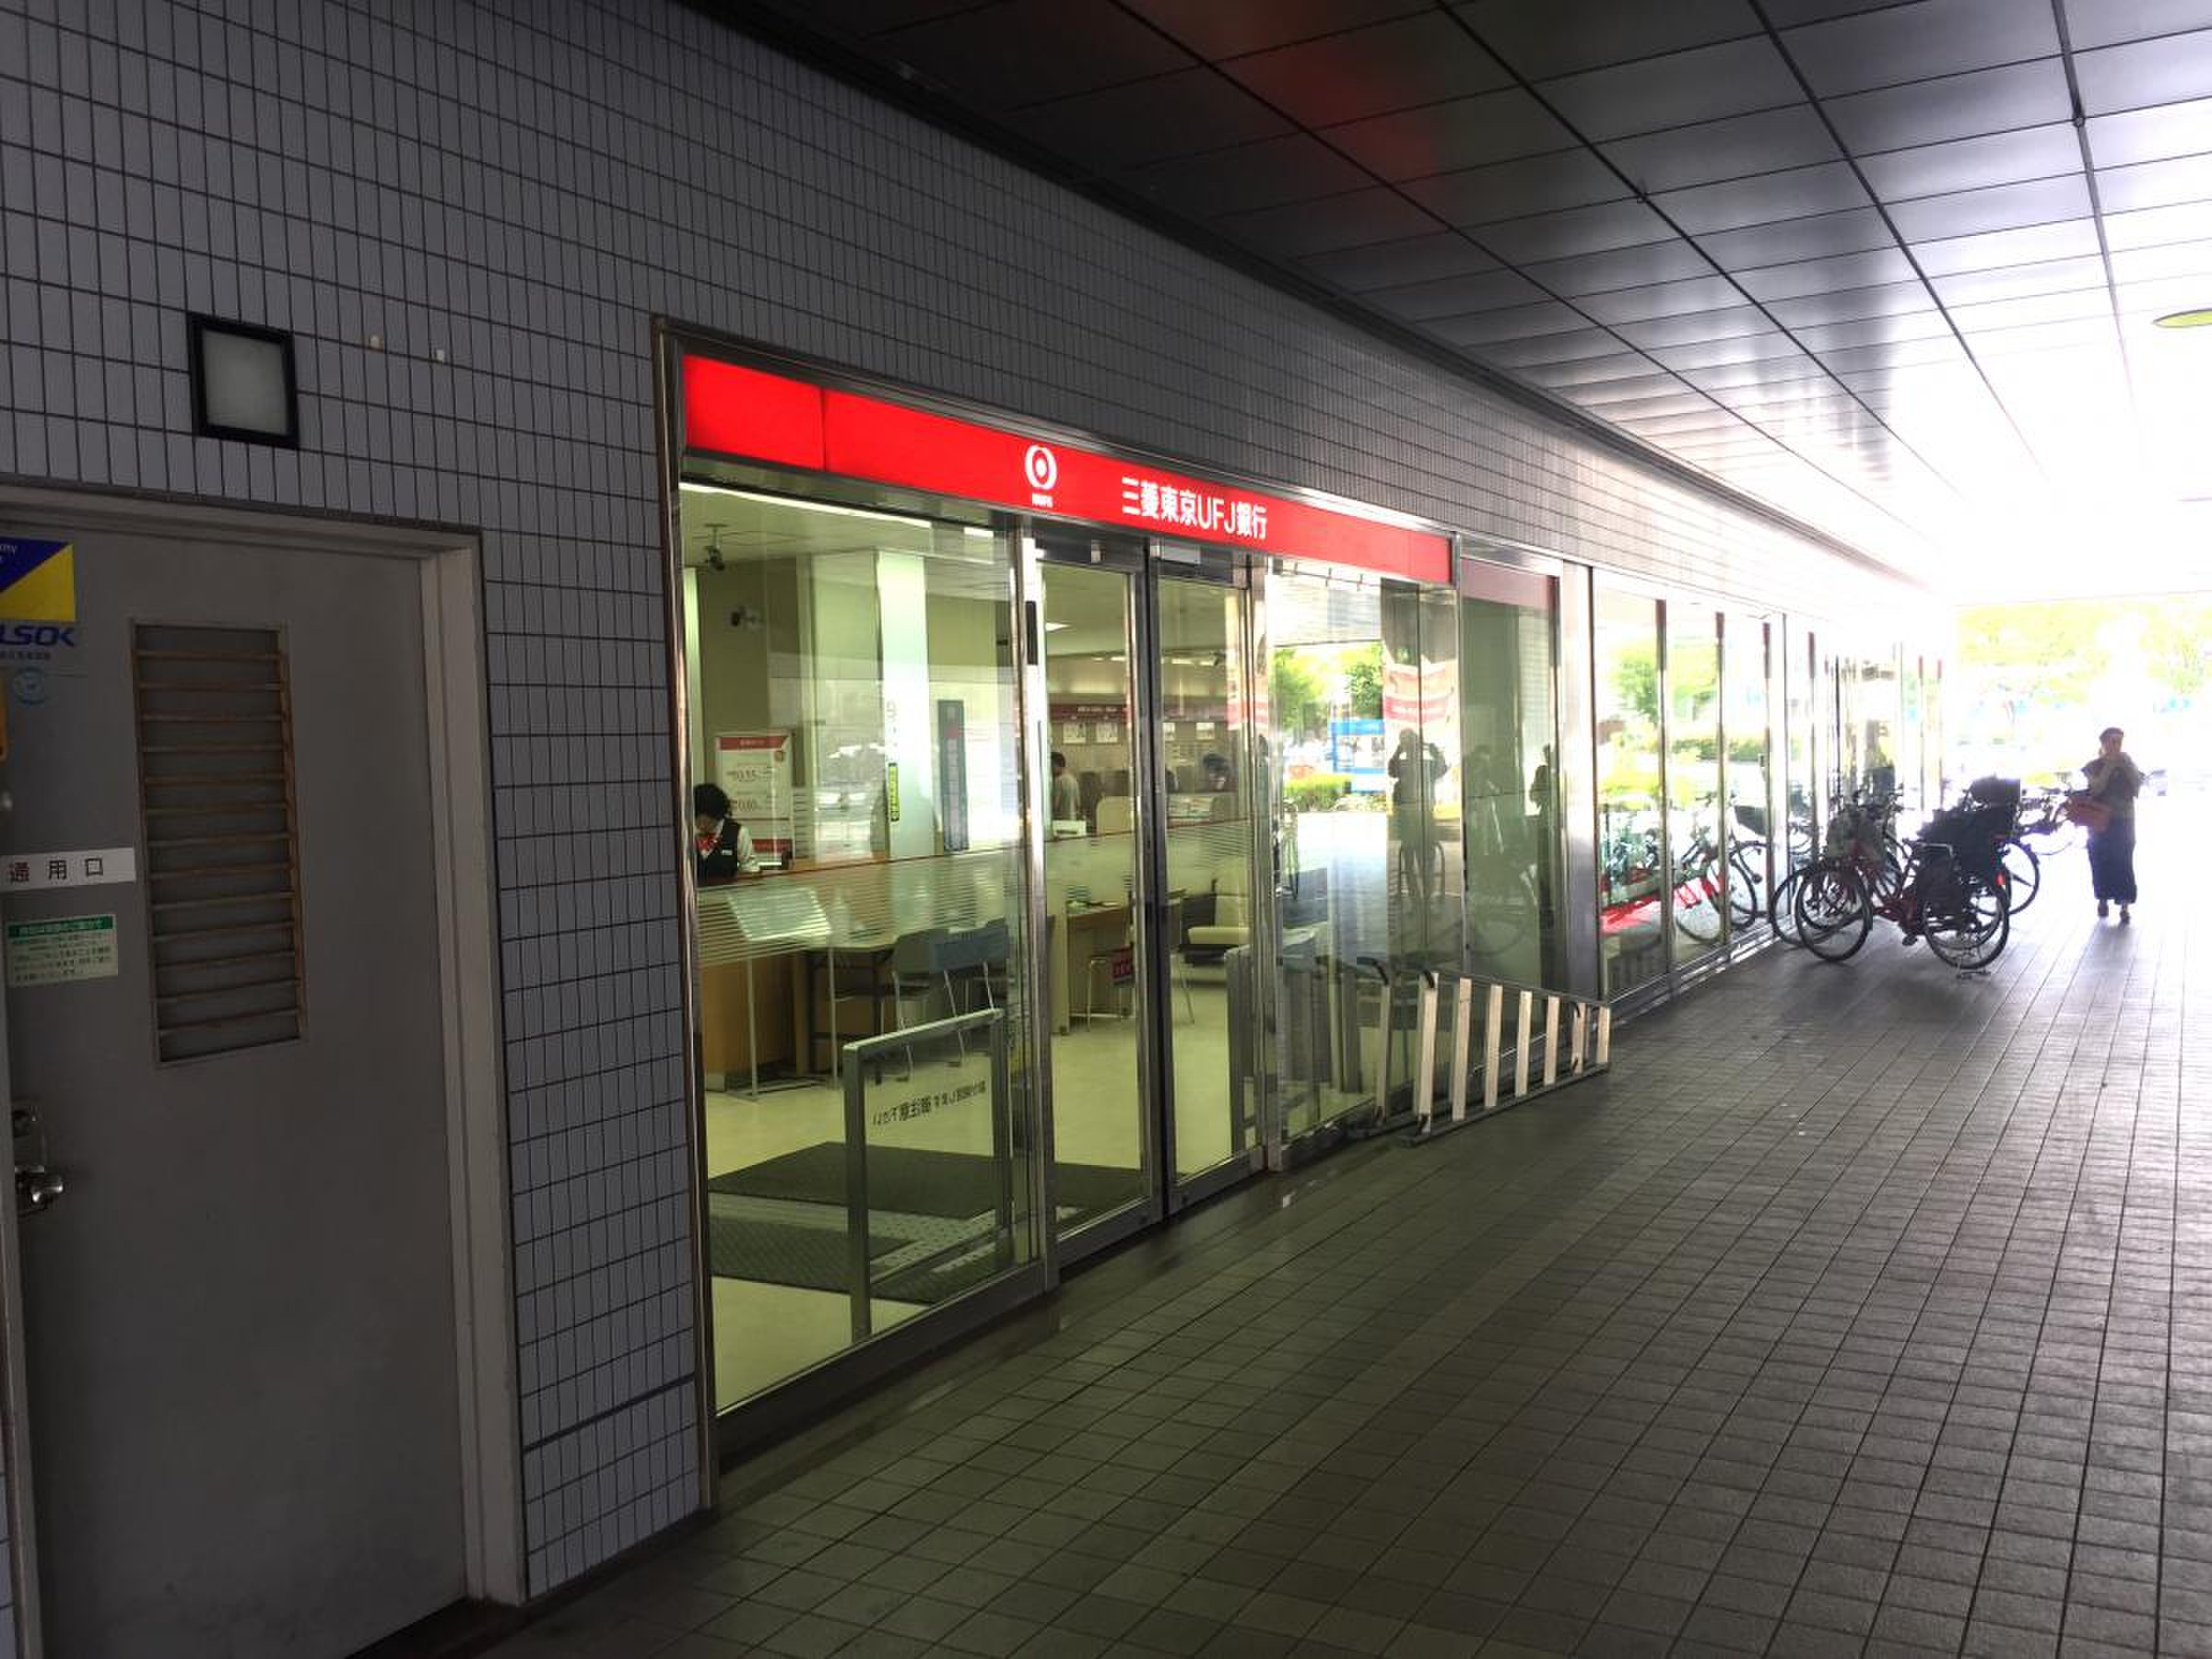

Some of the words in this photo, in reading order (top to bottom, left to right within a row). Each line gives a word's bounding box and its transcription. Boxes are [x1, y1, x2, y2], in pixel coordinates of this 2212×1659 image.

[1122, 477, 1267, 540] 三菱東京UFJ銀行
[0, 624, 75, 647] LSOK
[9, 857, 104, 882] 通用口
